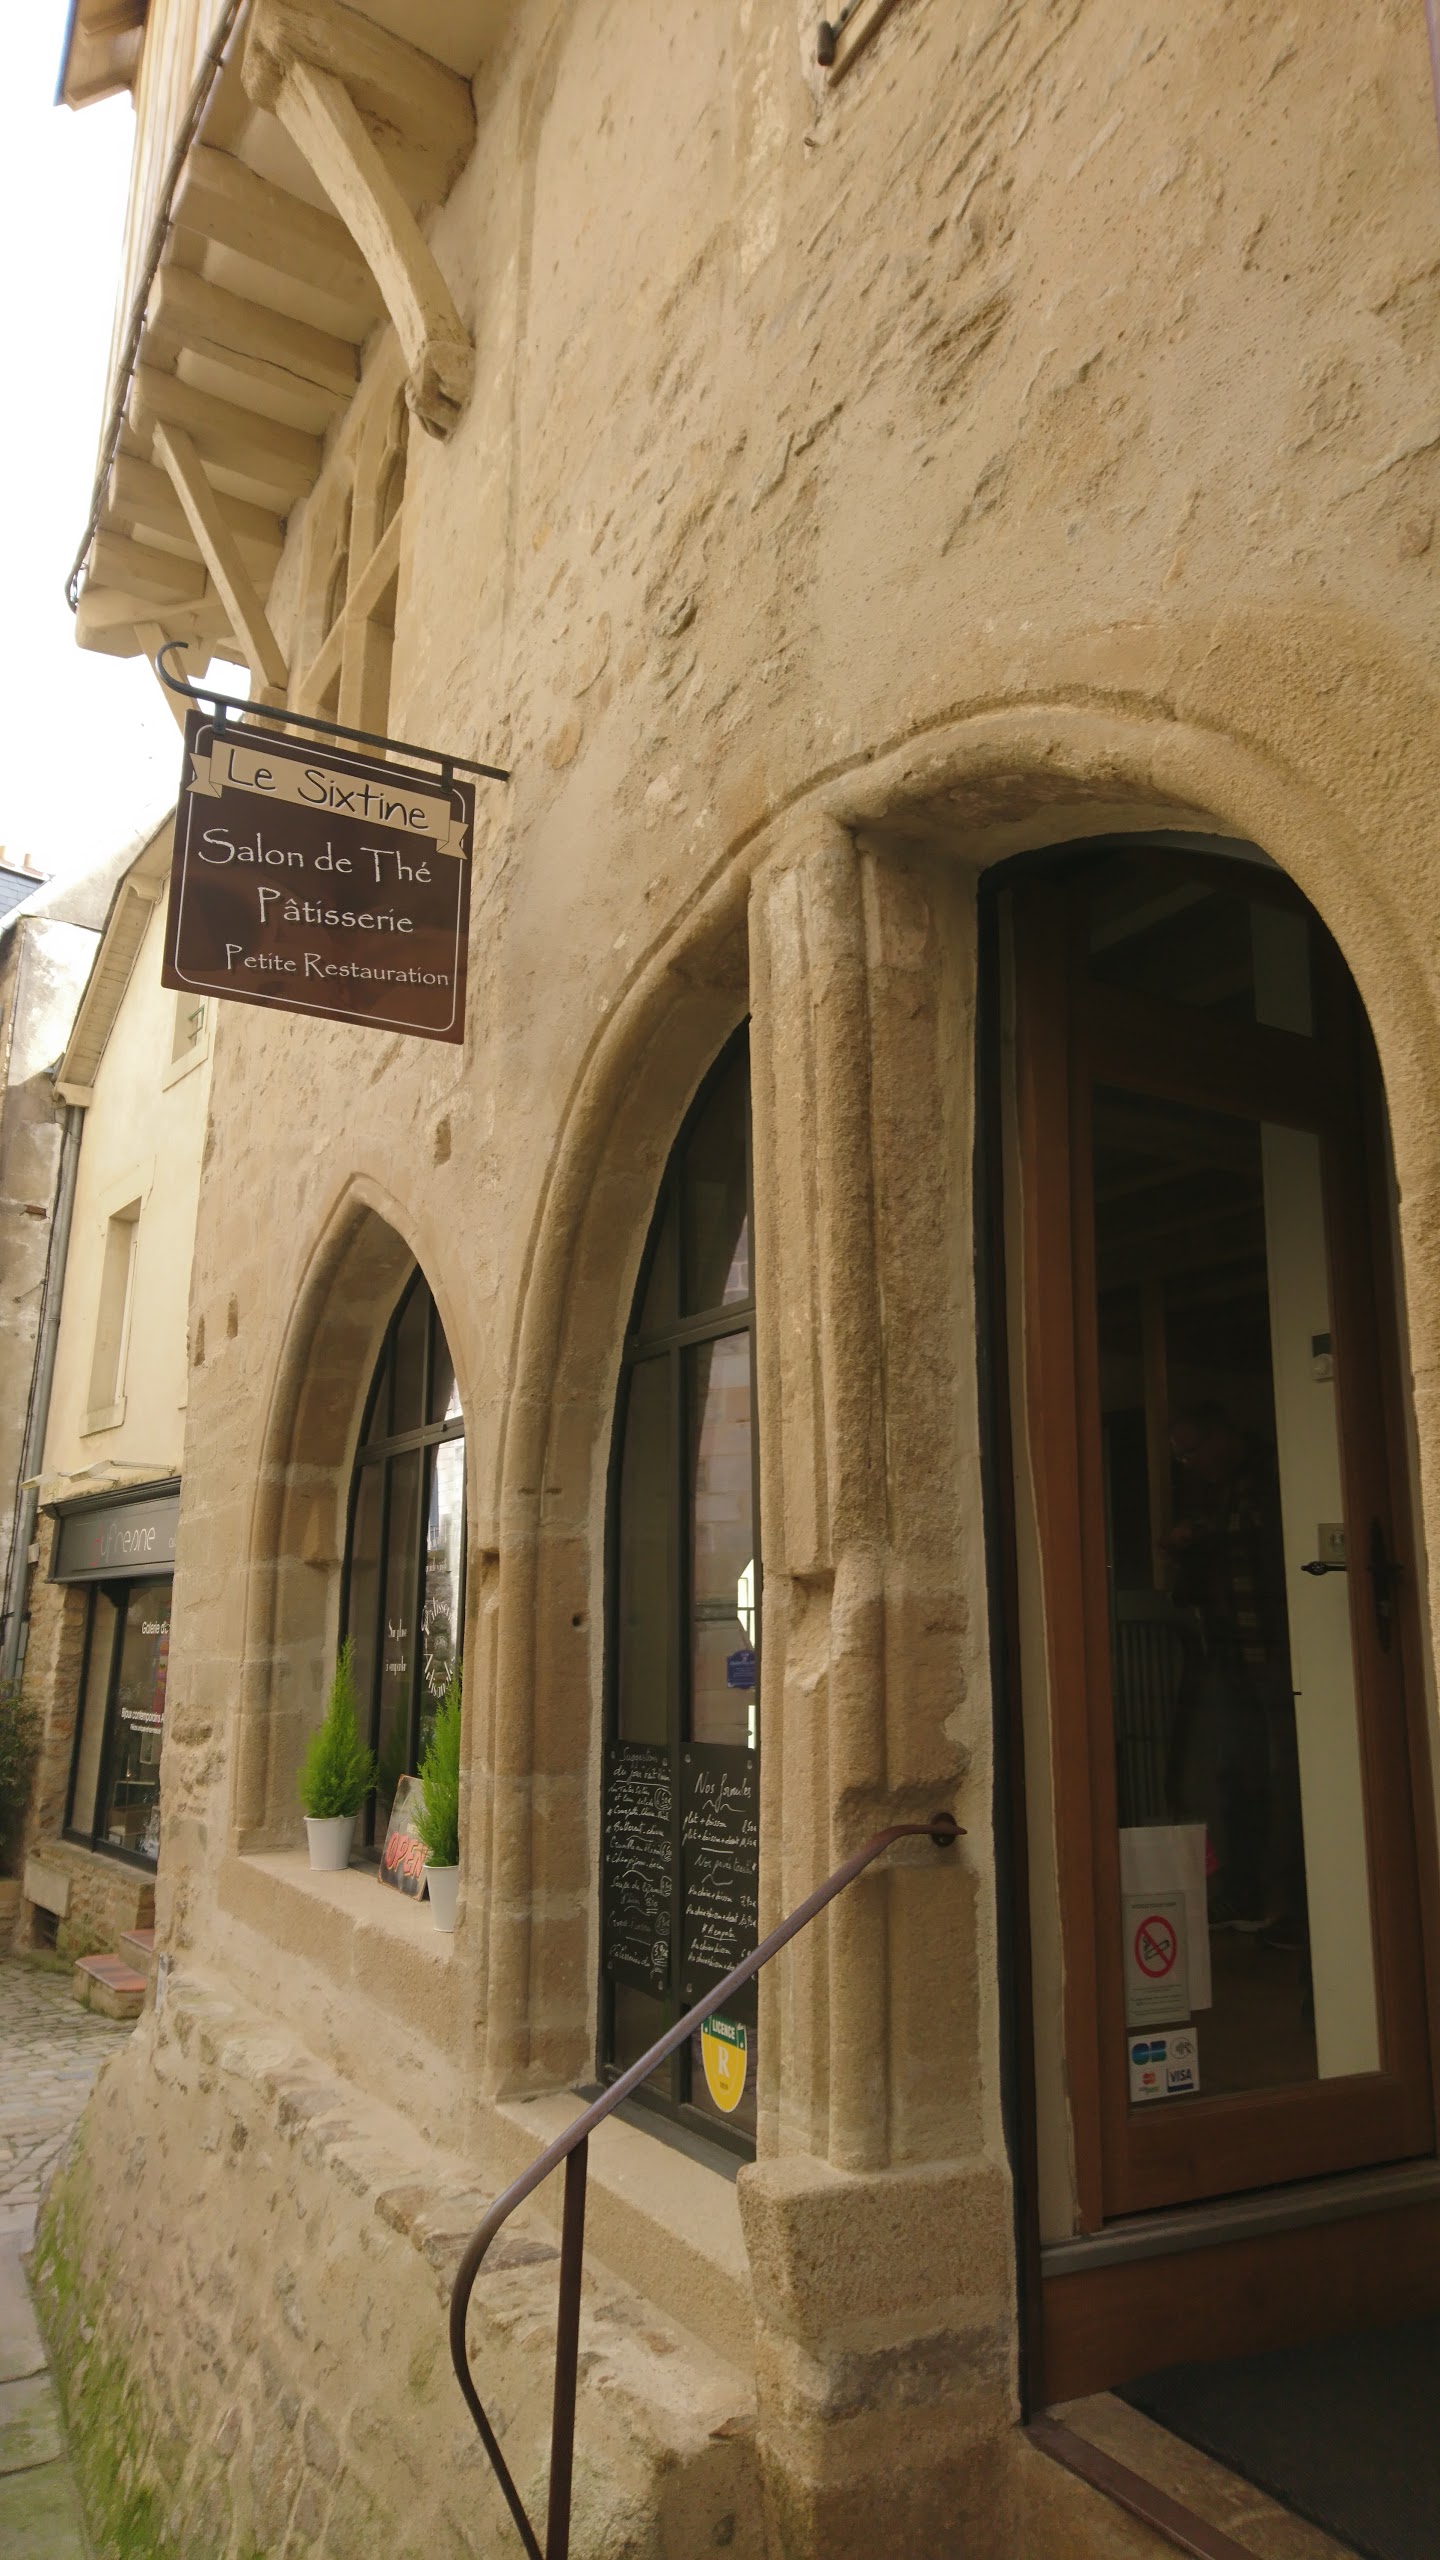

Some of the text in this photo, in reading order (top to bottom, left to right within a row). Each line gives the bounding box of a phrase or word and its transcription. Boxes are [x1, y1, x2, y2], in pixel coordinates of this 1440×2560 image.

[227, 748, 430, 831] Le Sixtine
[198, 828, 433, 884] Salon de Thé
[257, 887, 415, 934] Pâtisserie
[225, 943, 450, 987] Petite Restauration
[695, 1771, 715, 1794] Nos
[385, 1831, 431, 1879] OPEN
[717, 2045, 731, 2078] R
[1169, 2068, 1193, 2083] VISA
